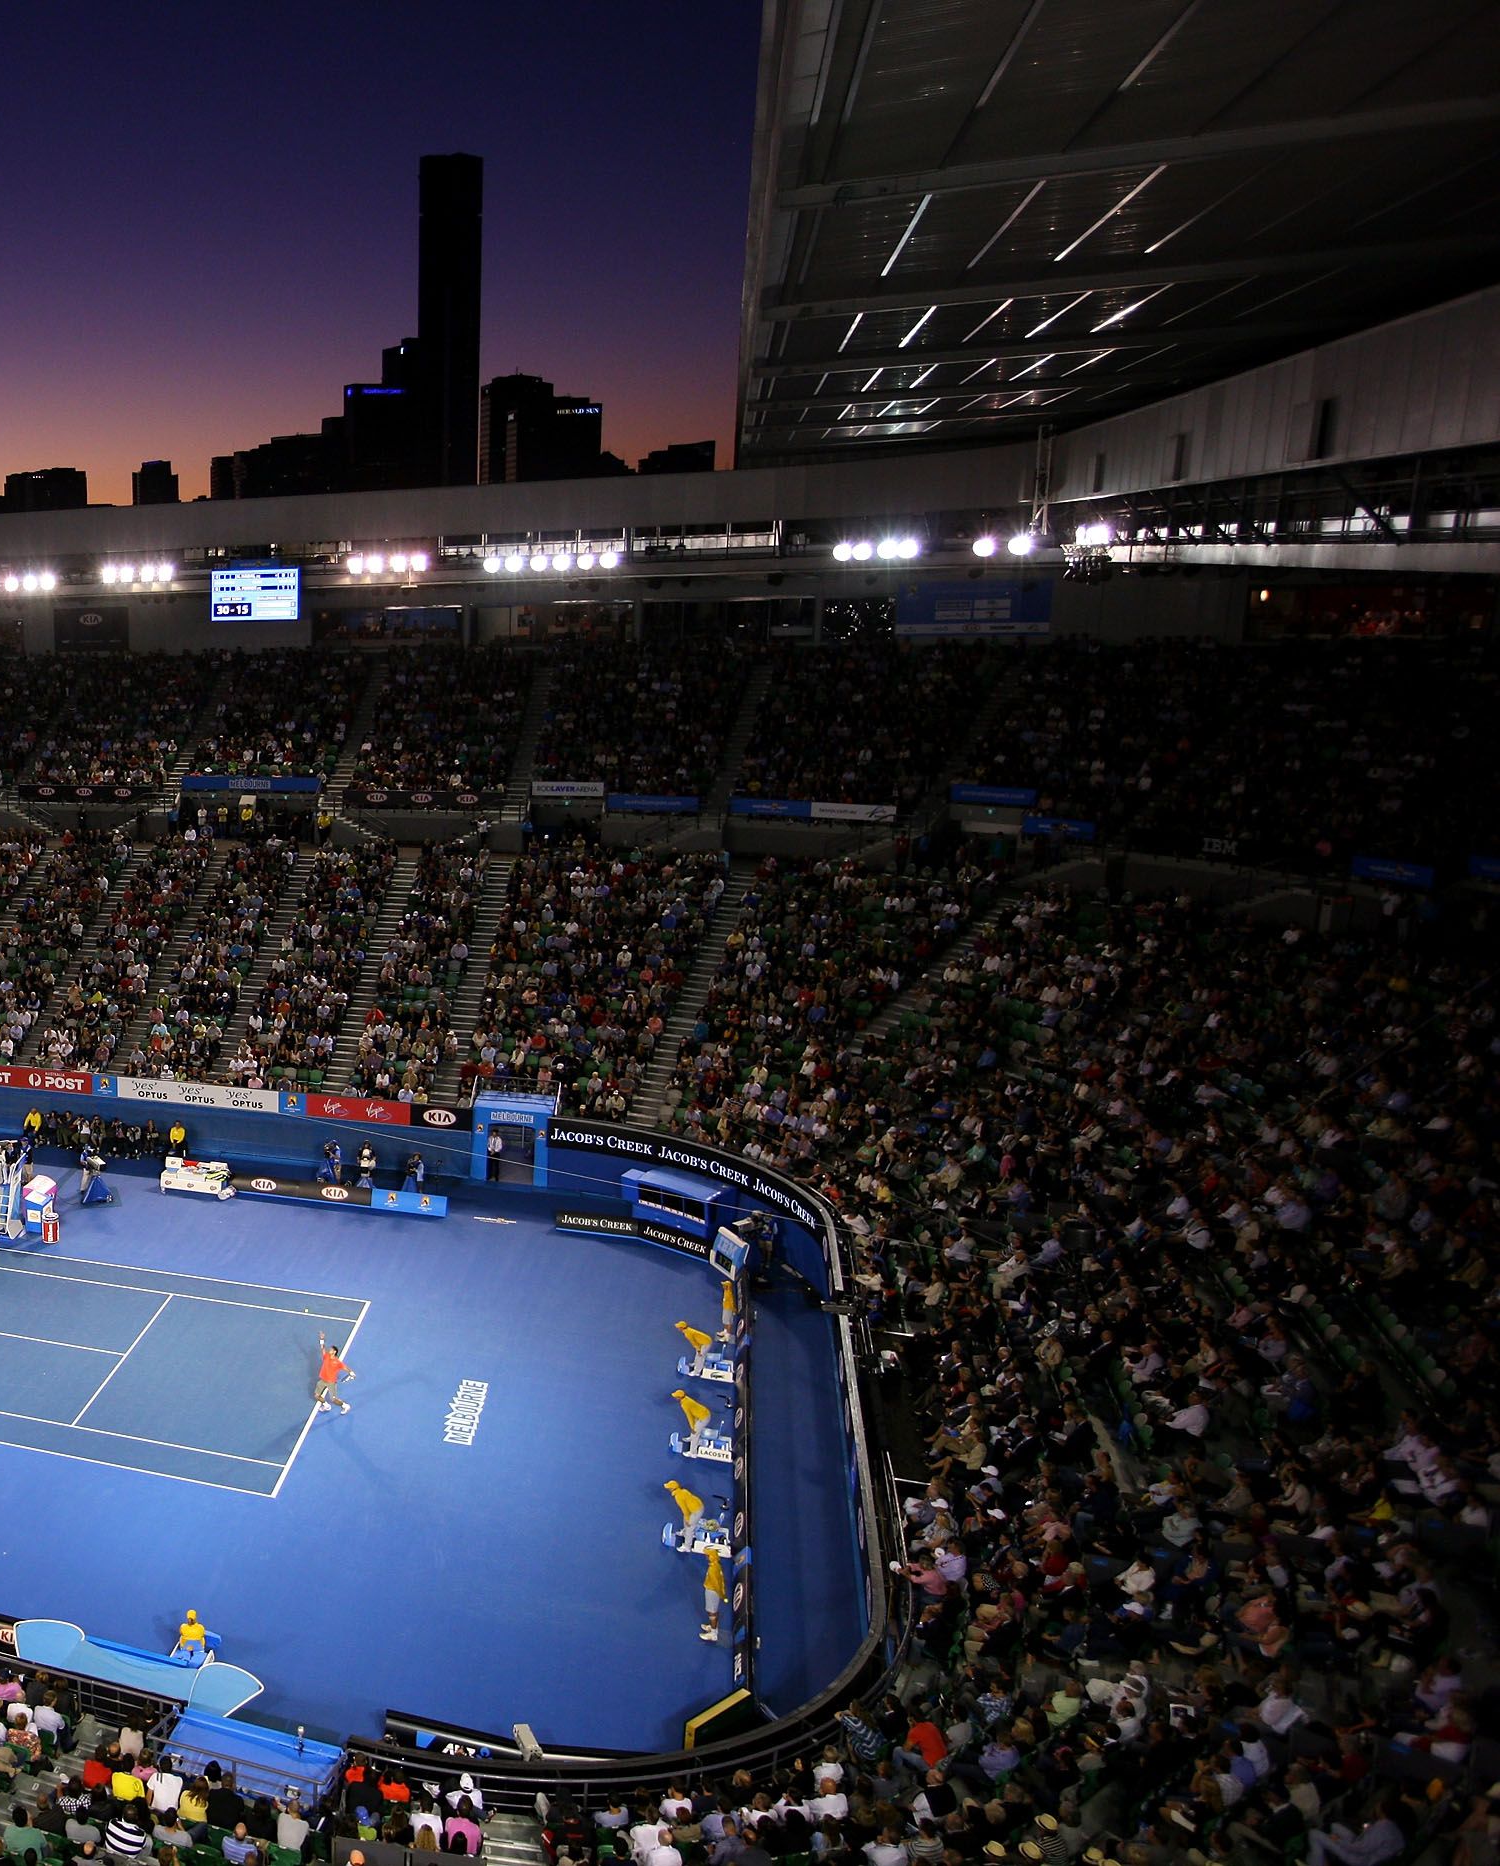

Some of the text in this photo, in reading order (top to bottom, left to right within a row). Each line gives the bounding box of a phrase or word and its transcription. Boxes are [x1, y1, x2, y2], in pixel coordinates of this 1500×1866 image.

[83, 615, 100, 624] KIA
[229, 779, 271, 790] MELBOURNE
[38, 788, 54, 796] KIA
[76, 788, 92, 796] KIA
[114, 788, 129, 796] KIA
[415, 794, 429, 802] KIA
[460, 795, 475, 803] KIA
[1202, 836, 1238, 856] IBM
[44, 1076, 85, 1090] POST
[138, 1091, 168, 1100] OPTUS
[184, 1095, 215, 1104] OPTUS
[232, 1100, 263, 1109] OPTUS
[323, 1099, 342, 1115] Virgin
[365, 1102, 384, 1118] Virgin
[428, 1111, 451, 1123] KIA
[491, 1112, 533, 1123] MELBOURNE
[550, 1128, 653, 1155] JACOB'S CREEK
[658, 1146, 749, 1186] JACOB'S CREEK
[254, 1180, 273, 1190] KIA
[325, 1188, 345, 1198] KIA
[753, 1177, 817, 1230] JACOB'S CREEK
[561, 1214, 633, 1232] JACOB'S CREEK
[643, 1226, 707, 1254] JACOB'S CREEK
[444, 1380, 487, 1445] MELBOURNE
[700, 1450, 730, 1460] LACOSTE
[0, 1630, 14, 1641] KI
[31, 1782, 39, 1792] D
